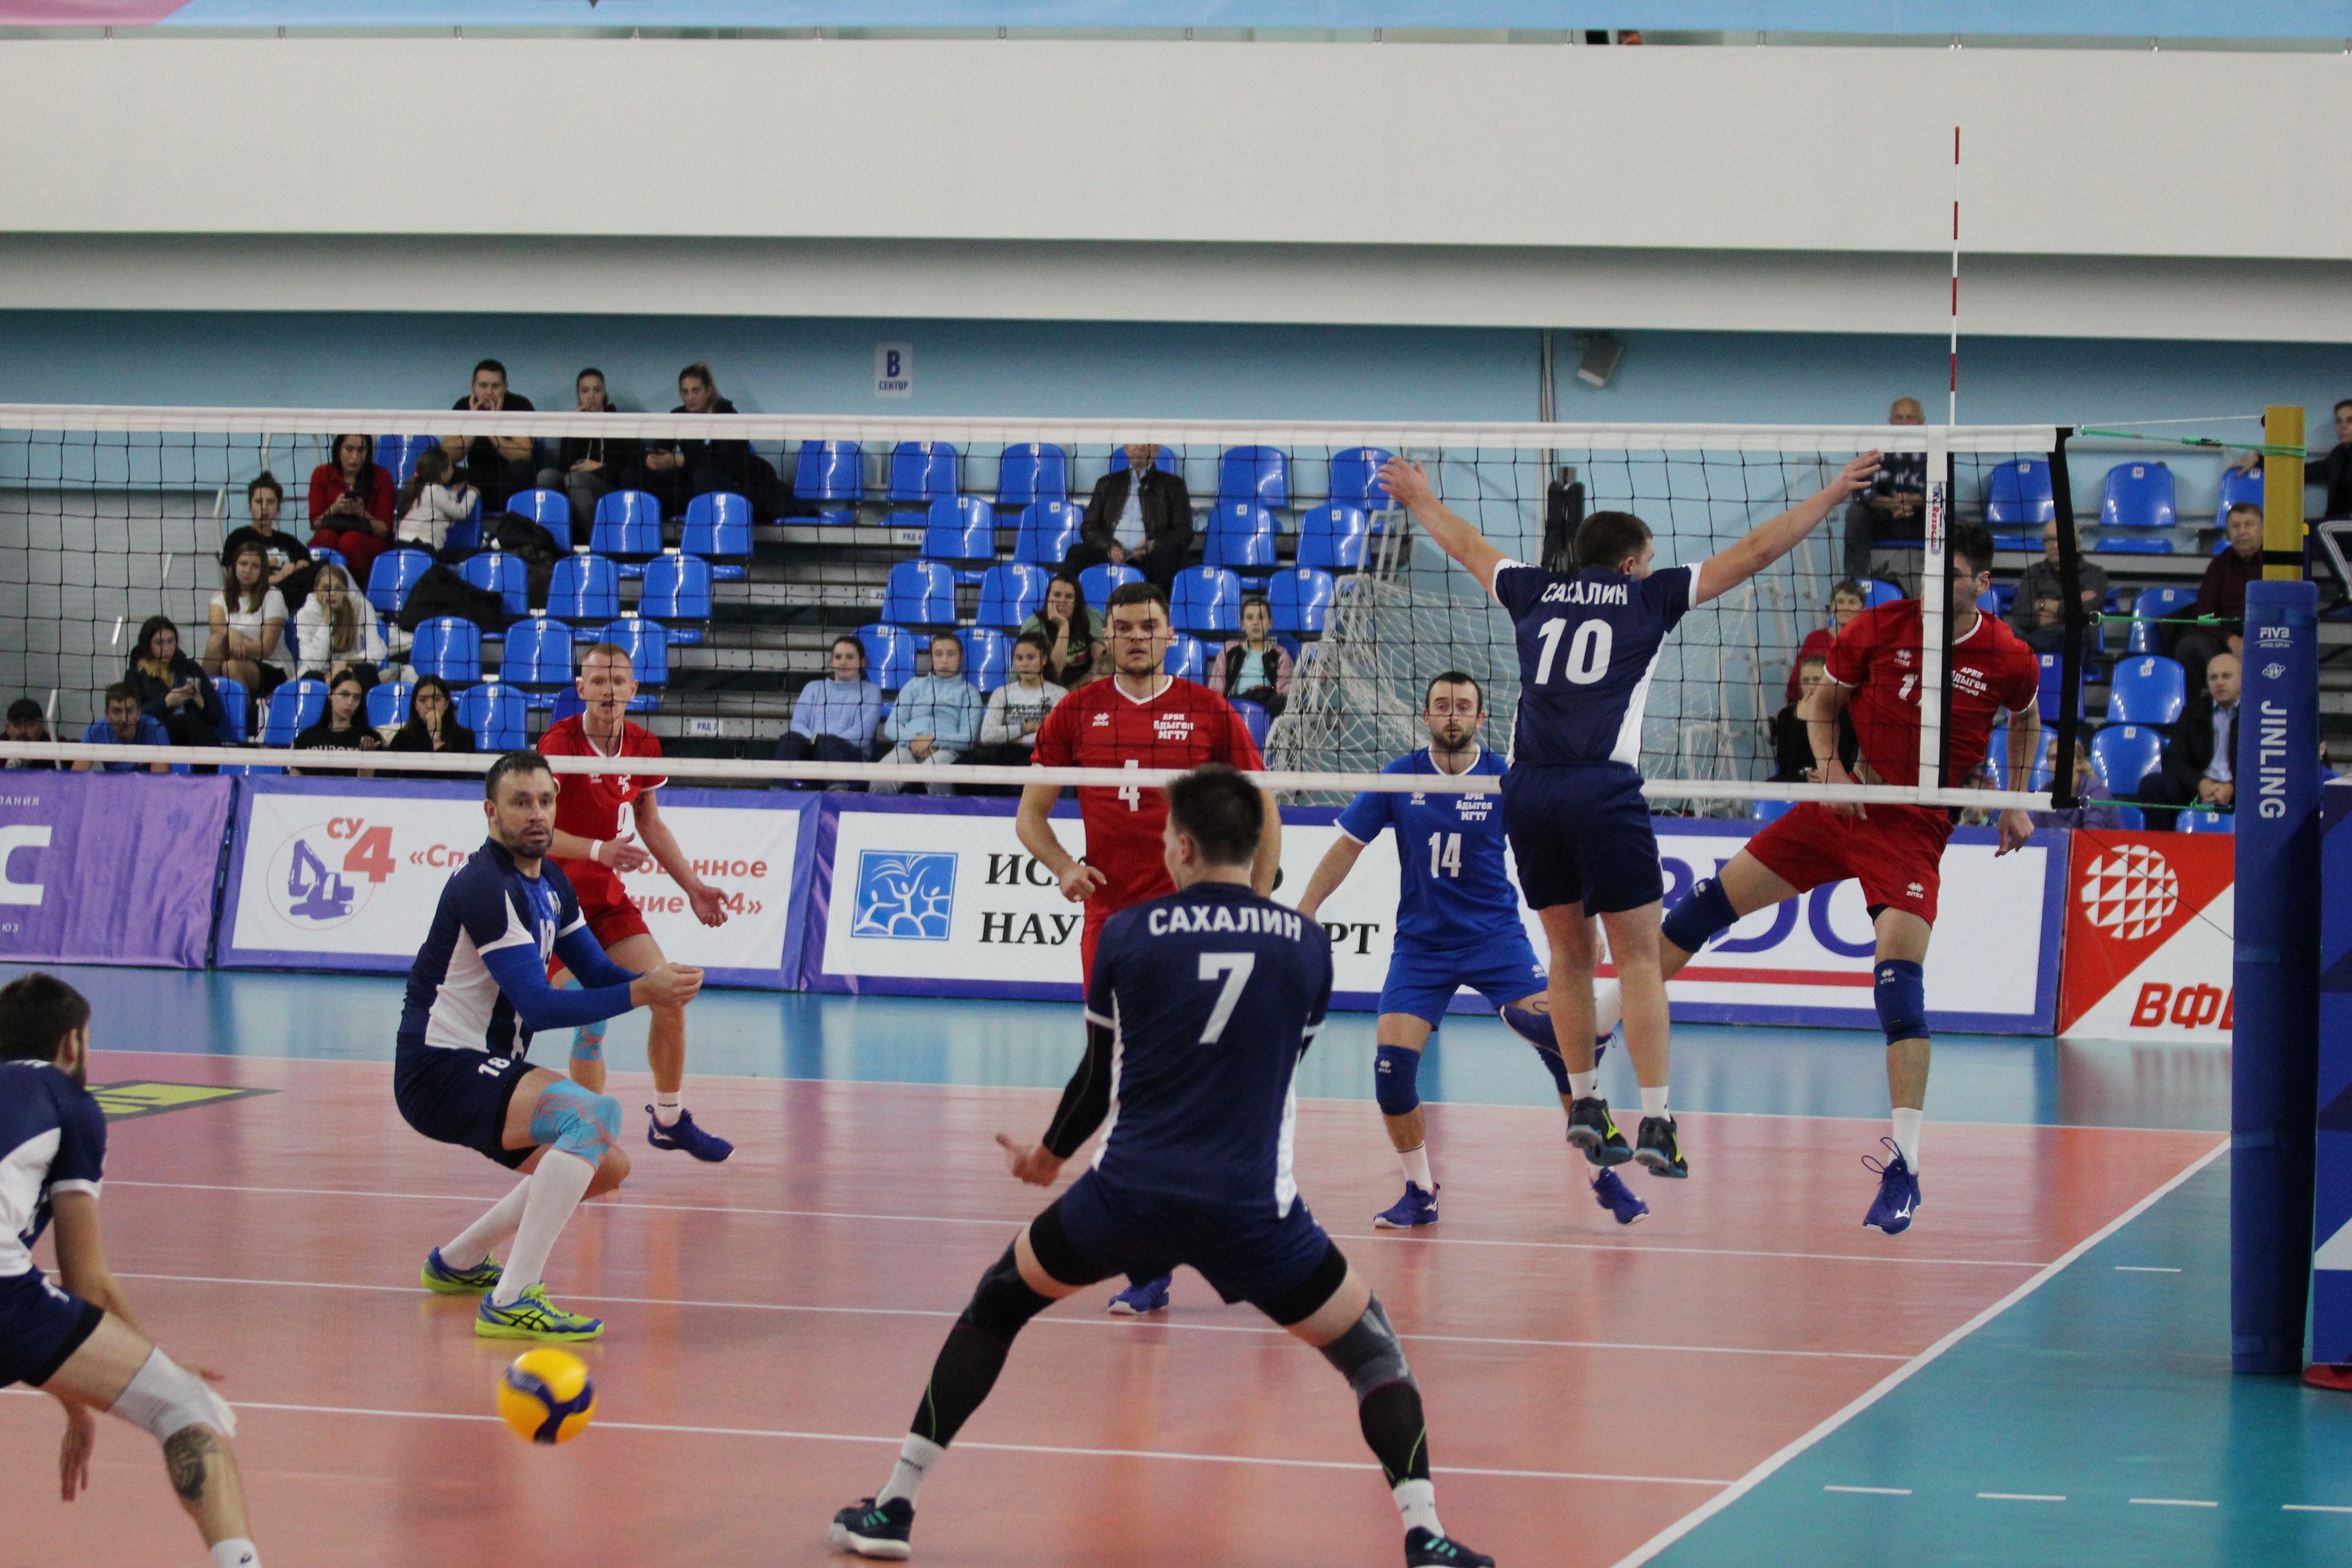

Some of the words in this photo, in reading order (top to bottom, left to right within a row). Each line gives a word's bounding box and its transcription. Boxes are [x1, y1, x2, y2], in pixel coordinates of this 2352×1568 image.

[879, 381, 908, 390] СЕКТОР
[2260, 626, 2290, 638] FIVB
[1535, 617, 1613, 685] 10
[698, 722, 711, 731] РЯД
[1158, 730, 1188, 740] МГТУ
[2259, 700, 2287, 819] JINLING
[1118, 759, 1141, 812] 4
[1455, 800, 1493, 810] Адыгея
[1461, 811, 1488, 821] МГТУ
[343, 825, 396, 883] 4
[1428, 831, 1462, 879] 14
[1148, 905, 1302, 942] САХАЛИН
[1199, 952, 1256, 1045] 7
[478, 1056, 511, 1078] 18
